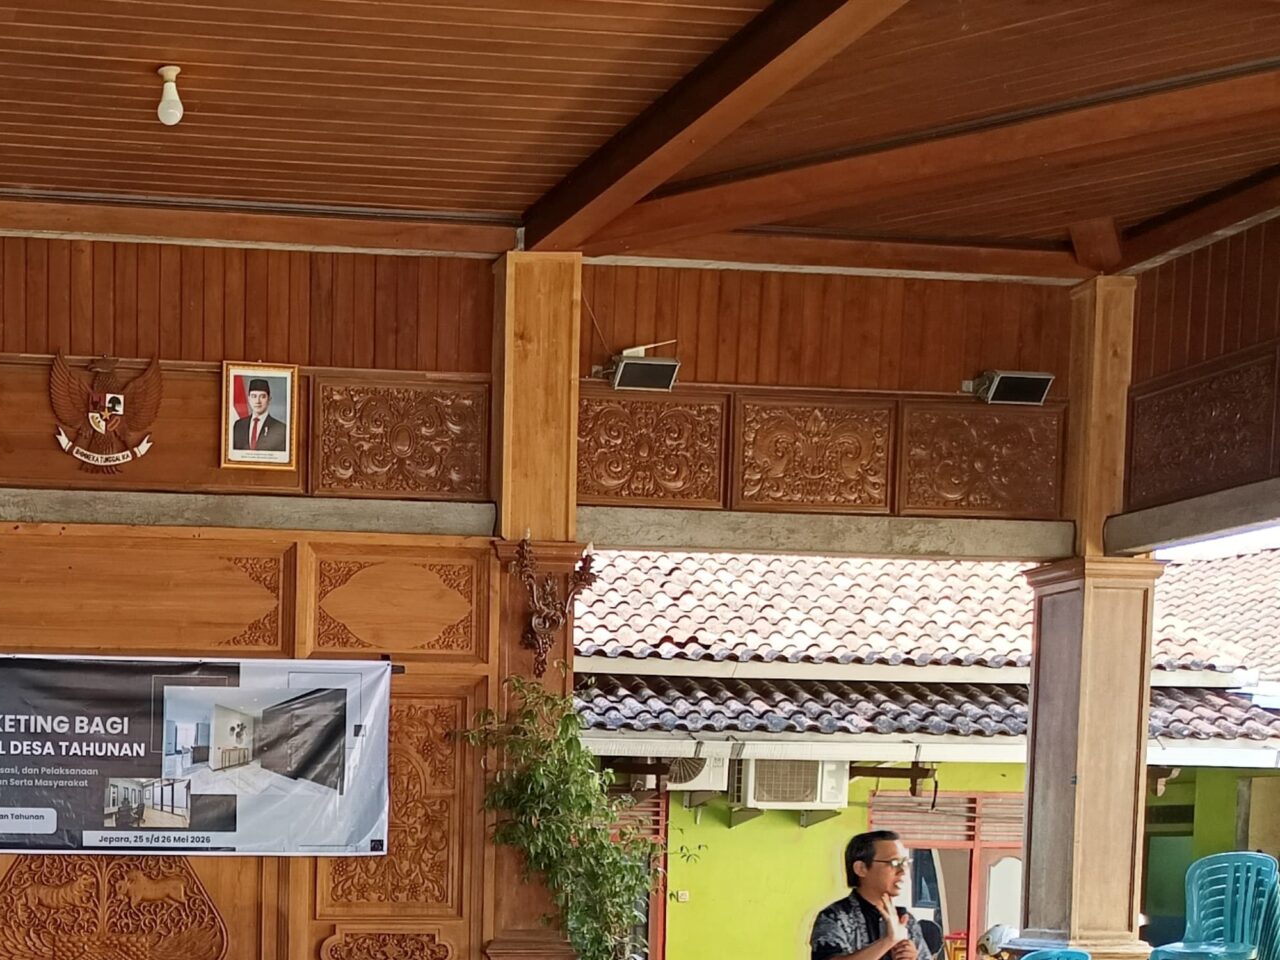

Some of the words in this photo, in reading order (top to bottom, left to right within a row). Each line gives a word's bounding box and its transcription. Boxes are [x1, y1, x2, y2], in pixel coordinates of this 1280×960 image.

[75, 716, 129, 735] BAGI
[10, 741, 55, 756] DESA
[59, 742, 145, 757] TAHUNAN
[22, 766, 38, 774] dan
[41, 767, 99, 775] Pelaksanaan
[10, 778, 33, 787] Serta
[35, 779, 88, 788] Masyarakat
[98, 835, 132, 844] Jepara,
[133, 835, 144, 844] 25
[145, 835, 160, 844] s/d
[161, 835, 172, 844] 26
[173, 836, 189, 844] Mei
[190, 836, 211, 844] 2026
